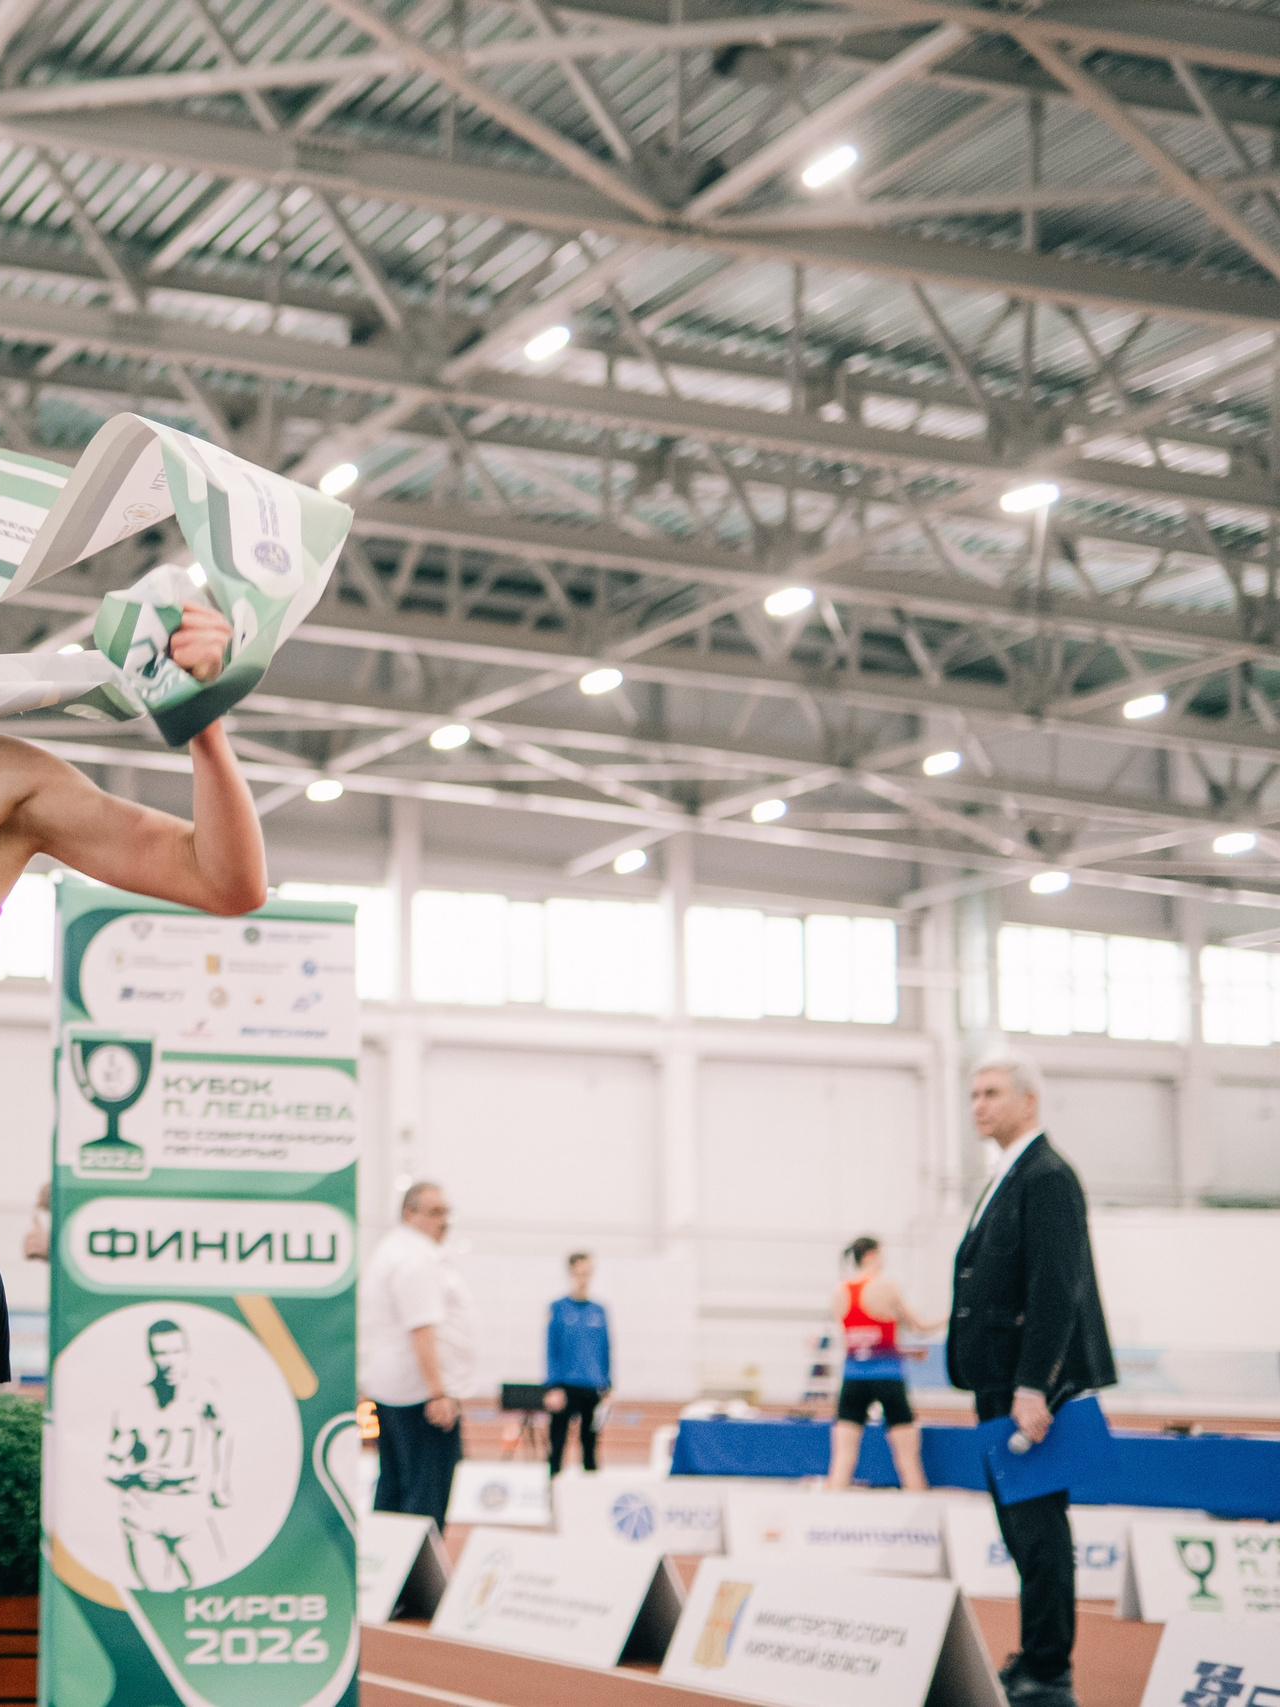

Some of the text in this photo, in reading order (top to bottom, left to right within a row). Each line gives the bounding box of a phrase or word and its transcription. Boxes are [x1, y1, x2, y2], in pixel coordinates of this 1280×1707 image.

[163, 1077, 273, 1096] КУБОК
[163, 1099, 355, 1121] П. ЛЕДНЕВА
[87, 1226, 338, 1264] ФИНИШ
[184, 1594, 328, 1623] КИРОВ
[184, 1627, 329, 1665] 2026
